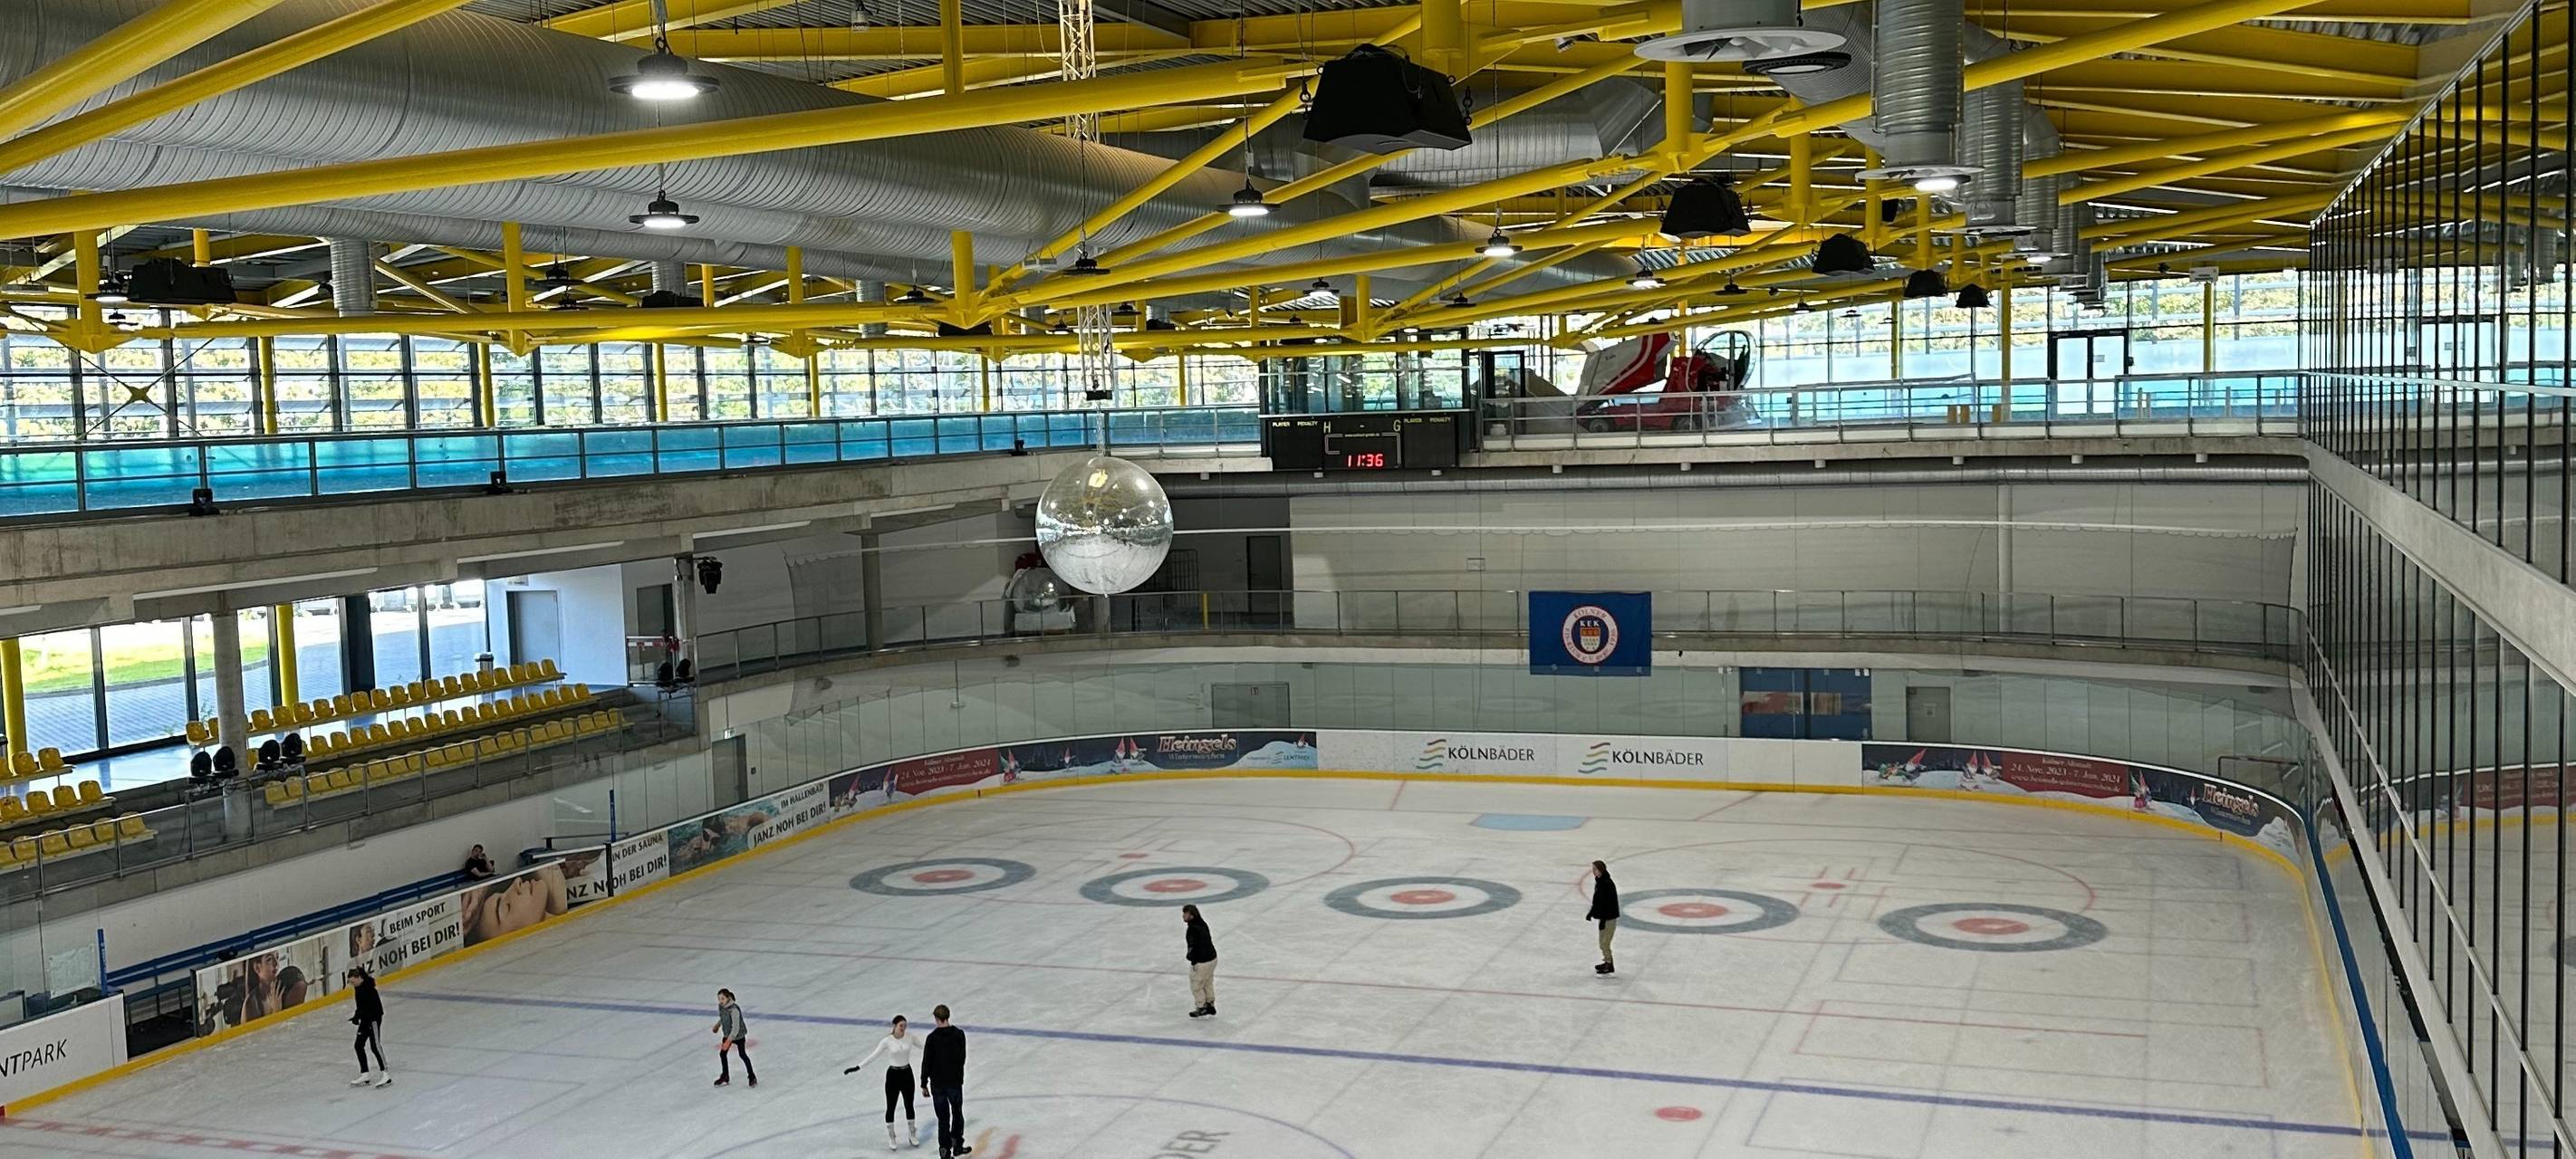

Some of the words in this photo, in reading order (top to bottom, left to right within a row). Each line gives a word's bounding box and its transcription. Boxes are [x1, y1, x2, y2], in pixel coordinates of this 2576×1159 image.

[1323, 421, 1331, 433] H
[1393, 419, 1401, 432] G
[1348, 453, 1384, 468] 11:36
[1448, 745, 1535, 761] KÖLNBÄDER
[1612, 748, 1703, 766] KÖLNBÄDER
[789, 783, 824, 805] HALLENBAD
[754, 826, 774, 848] JANZ
[776, 818, 794, 833] NOH
[796, 810, 808, 825] BEI
[810, 801, 826, 819] DIR!
[622, 845, 637, 860] DER
[639, 833, 663, 851] SAUNA
[630, 866, 644, 882] BEI
[647, 854, 667, 874] DIR!
[389, 915, 413, 934] BEIM
[417, 902, 446, 923] SPORT
[379, 944, 408, 970] NOH
[412, 935, 431, 955] BEI
[434, 922, 460, 945] DIR!
